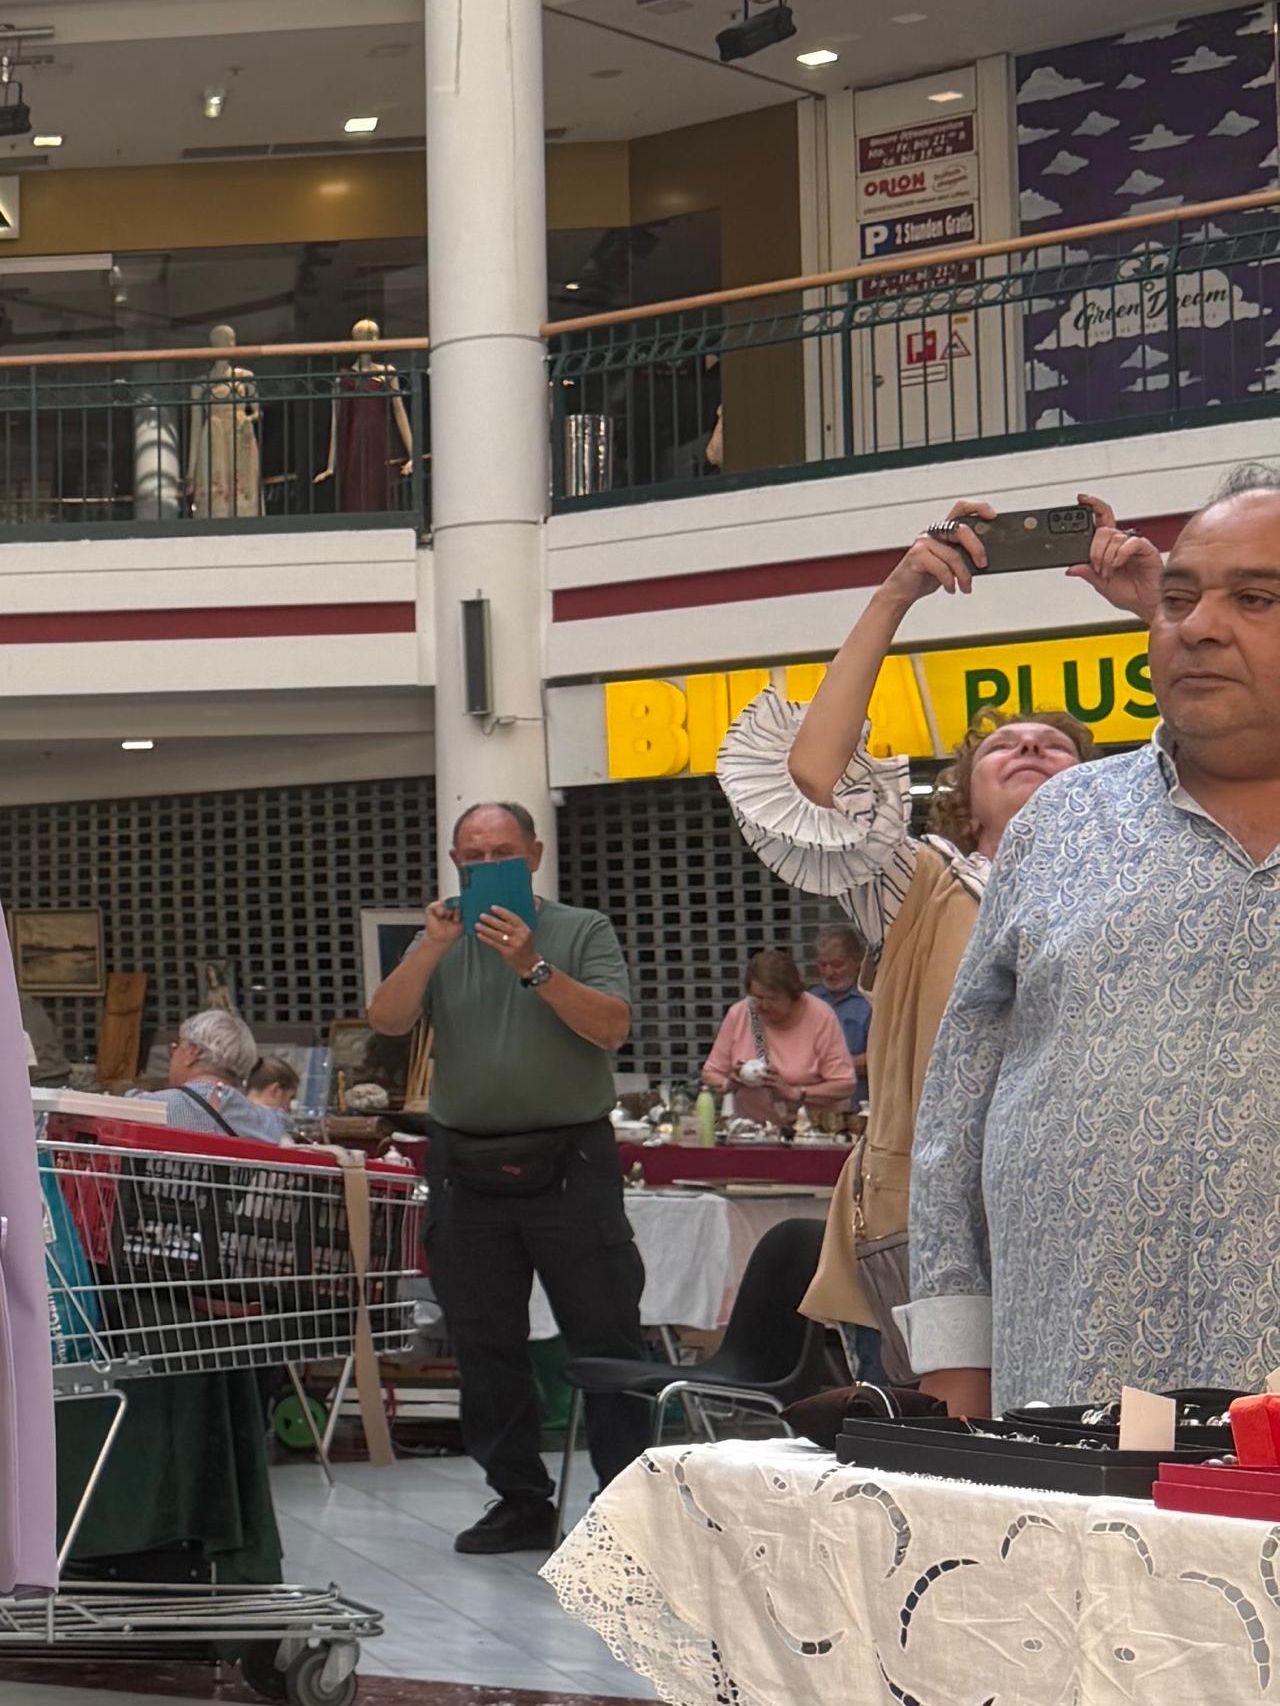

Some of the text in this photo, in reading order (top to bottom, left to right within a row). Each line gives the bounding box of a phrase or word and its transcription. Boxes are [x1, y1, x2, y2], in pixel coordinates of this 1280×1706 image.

[863, 171, 926, 197] ORION
[864, 224, 889, 256] P
[904, 216, 944, 243] Stunden
[945, 210, 974, 235] Gratis
[1073, 299, 1140, 331] Green
[1146, 288, 1227, 320] Deam
